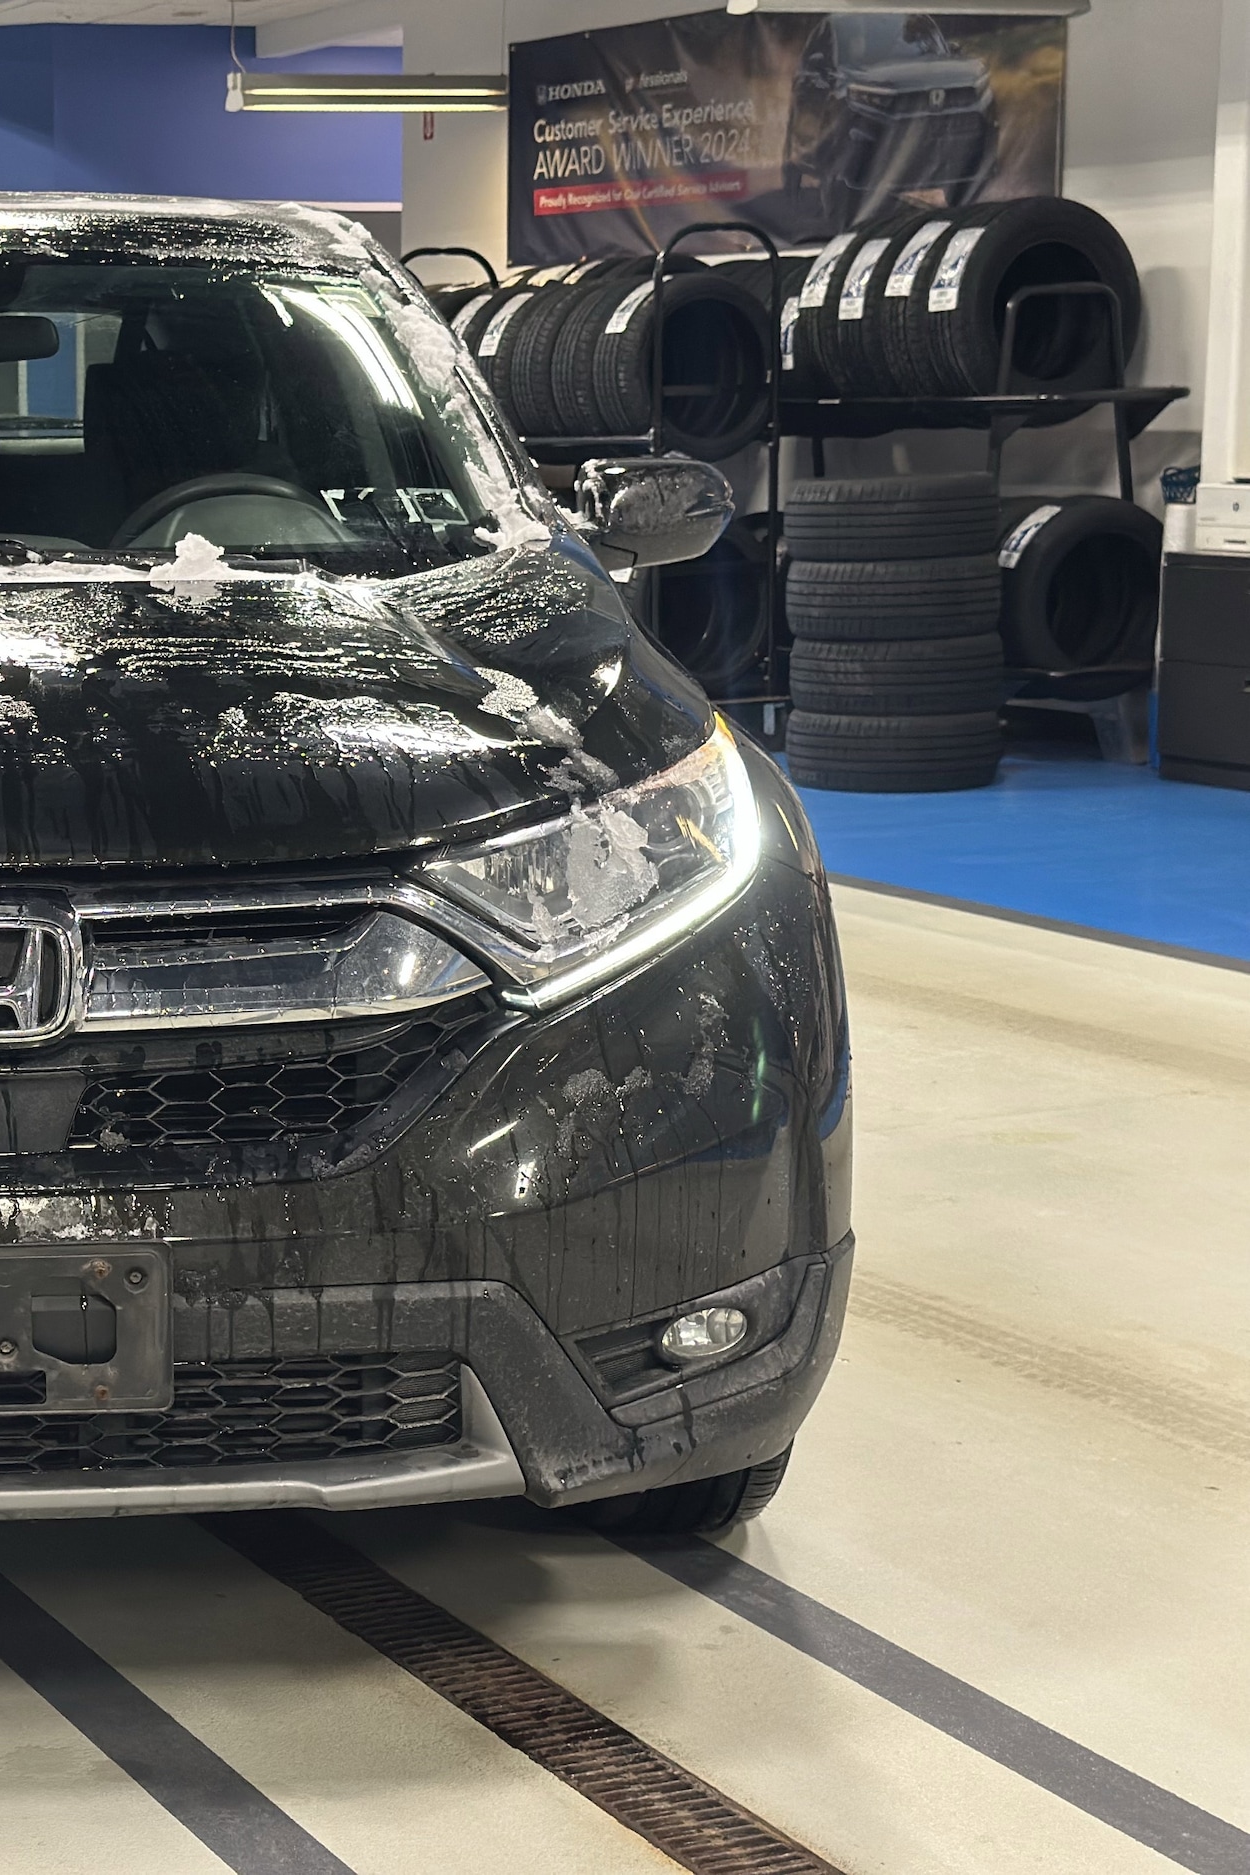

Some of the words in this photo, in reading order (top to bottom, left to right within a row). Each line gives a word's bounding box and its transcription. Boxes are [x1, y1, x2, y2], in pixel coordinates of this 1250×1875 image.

[548, 79, 606, 101] HONDA
[533, 117, 602, 144] Customer
[608, 107, 659, 135] Service
[661, 99, 754, 132] Experience
[533, 144, 606, 181] AWARD
[613, 135, 694, 173] WINNER
[699, 127, 750, 164] 2024
